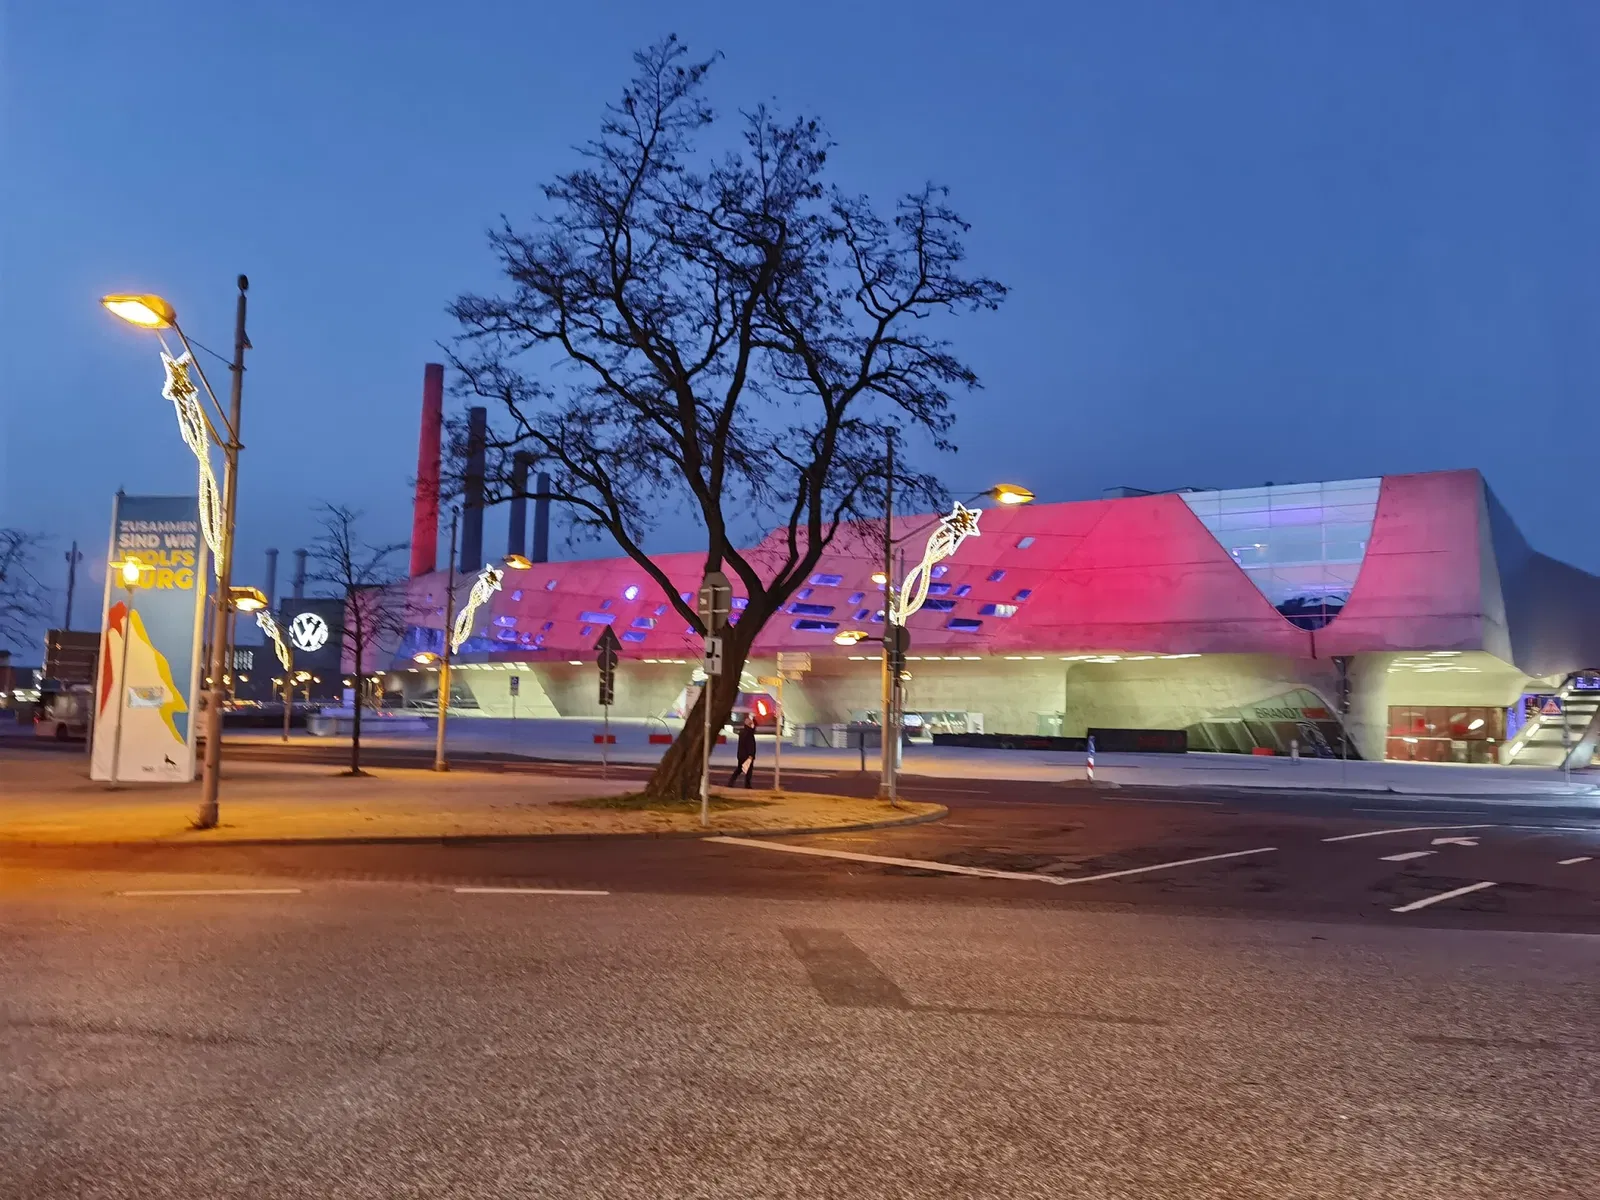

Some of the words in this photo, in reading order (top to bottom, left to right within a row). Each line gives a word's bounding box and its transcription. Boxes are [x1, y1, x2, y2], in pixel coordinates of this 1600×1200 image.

[120, 520, 198, 533] ZUSAMMEN
[119, 533, 160, 548] SIND
[164, 533, 197, 548] WIR
[290, 613, 328, 651] VW
